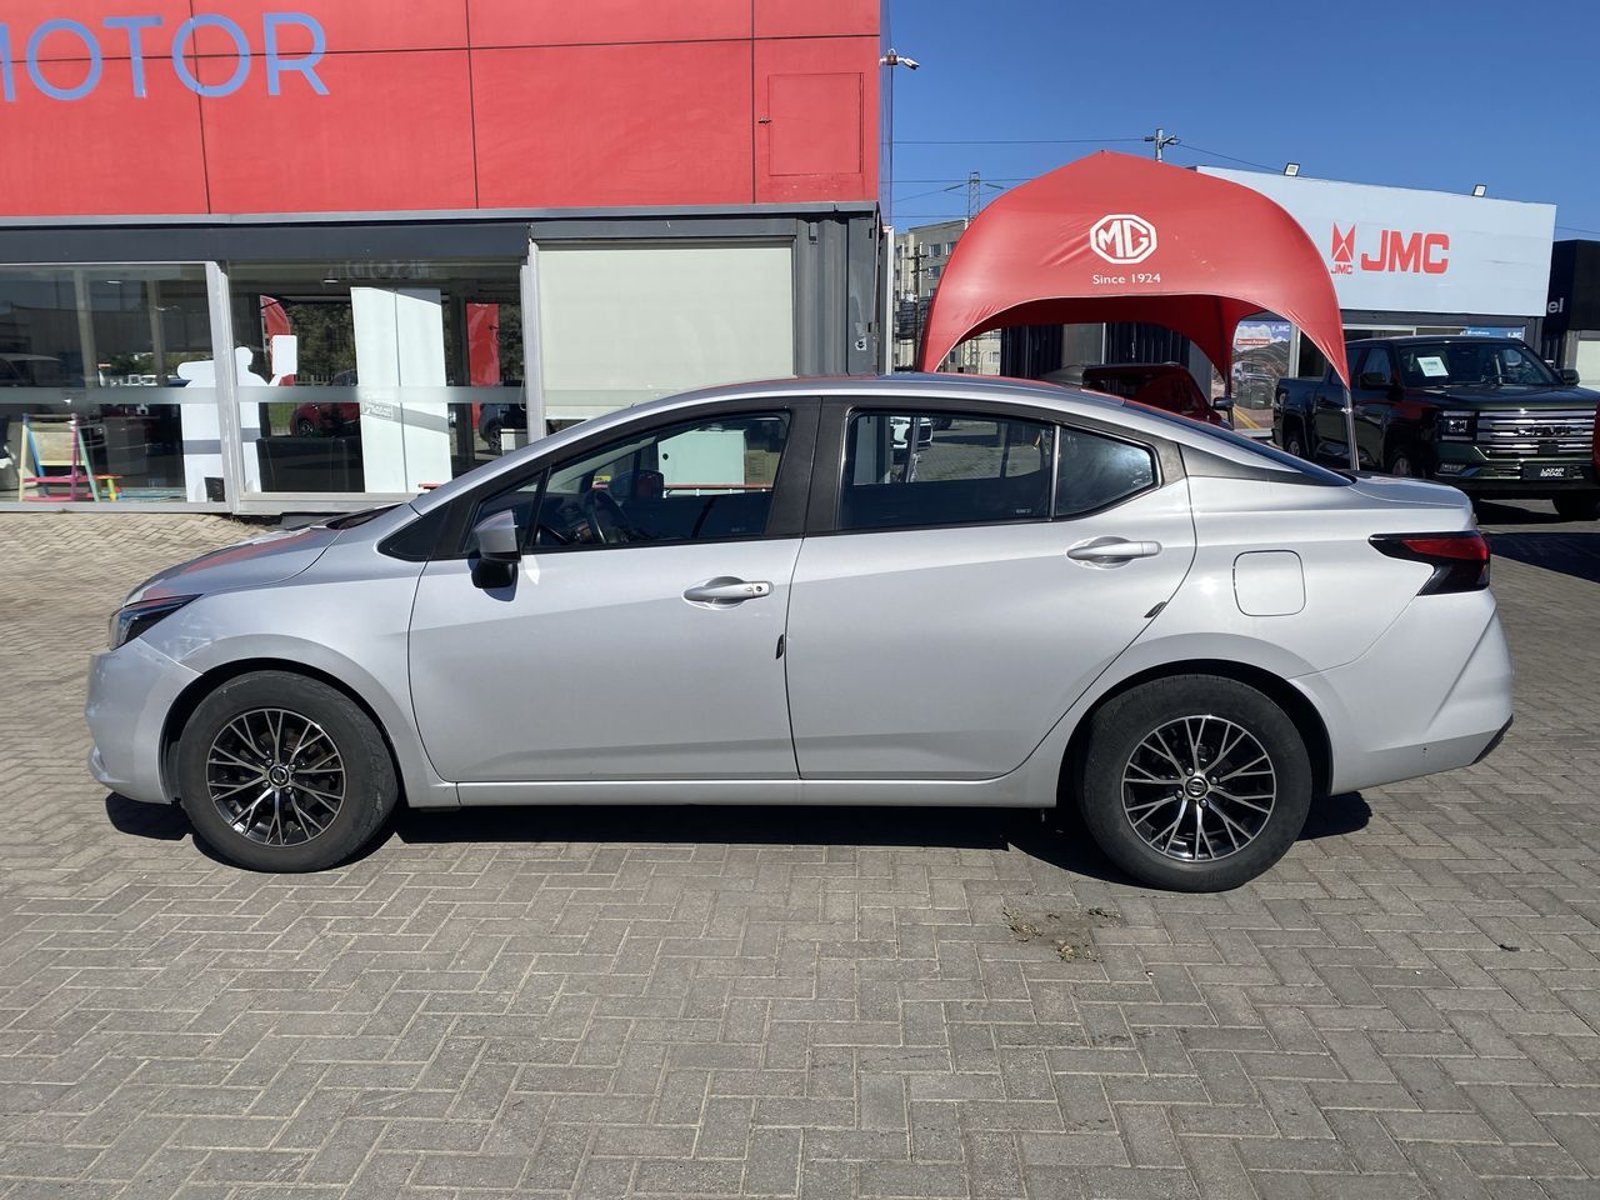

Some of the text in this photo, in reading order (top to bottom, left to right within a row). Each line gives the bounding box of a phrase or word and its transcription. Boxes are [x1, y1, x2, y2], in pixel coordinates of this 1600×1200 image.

[1096, 218, 1152, 259] MG
[1360, 229, 1450, 275] JMC
[1092, 273, 1161, 285] Since 1924
[1331, 264, 1353, 275] JMC
